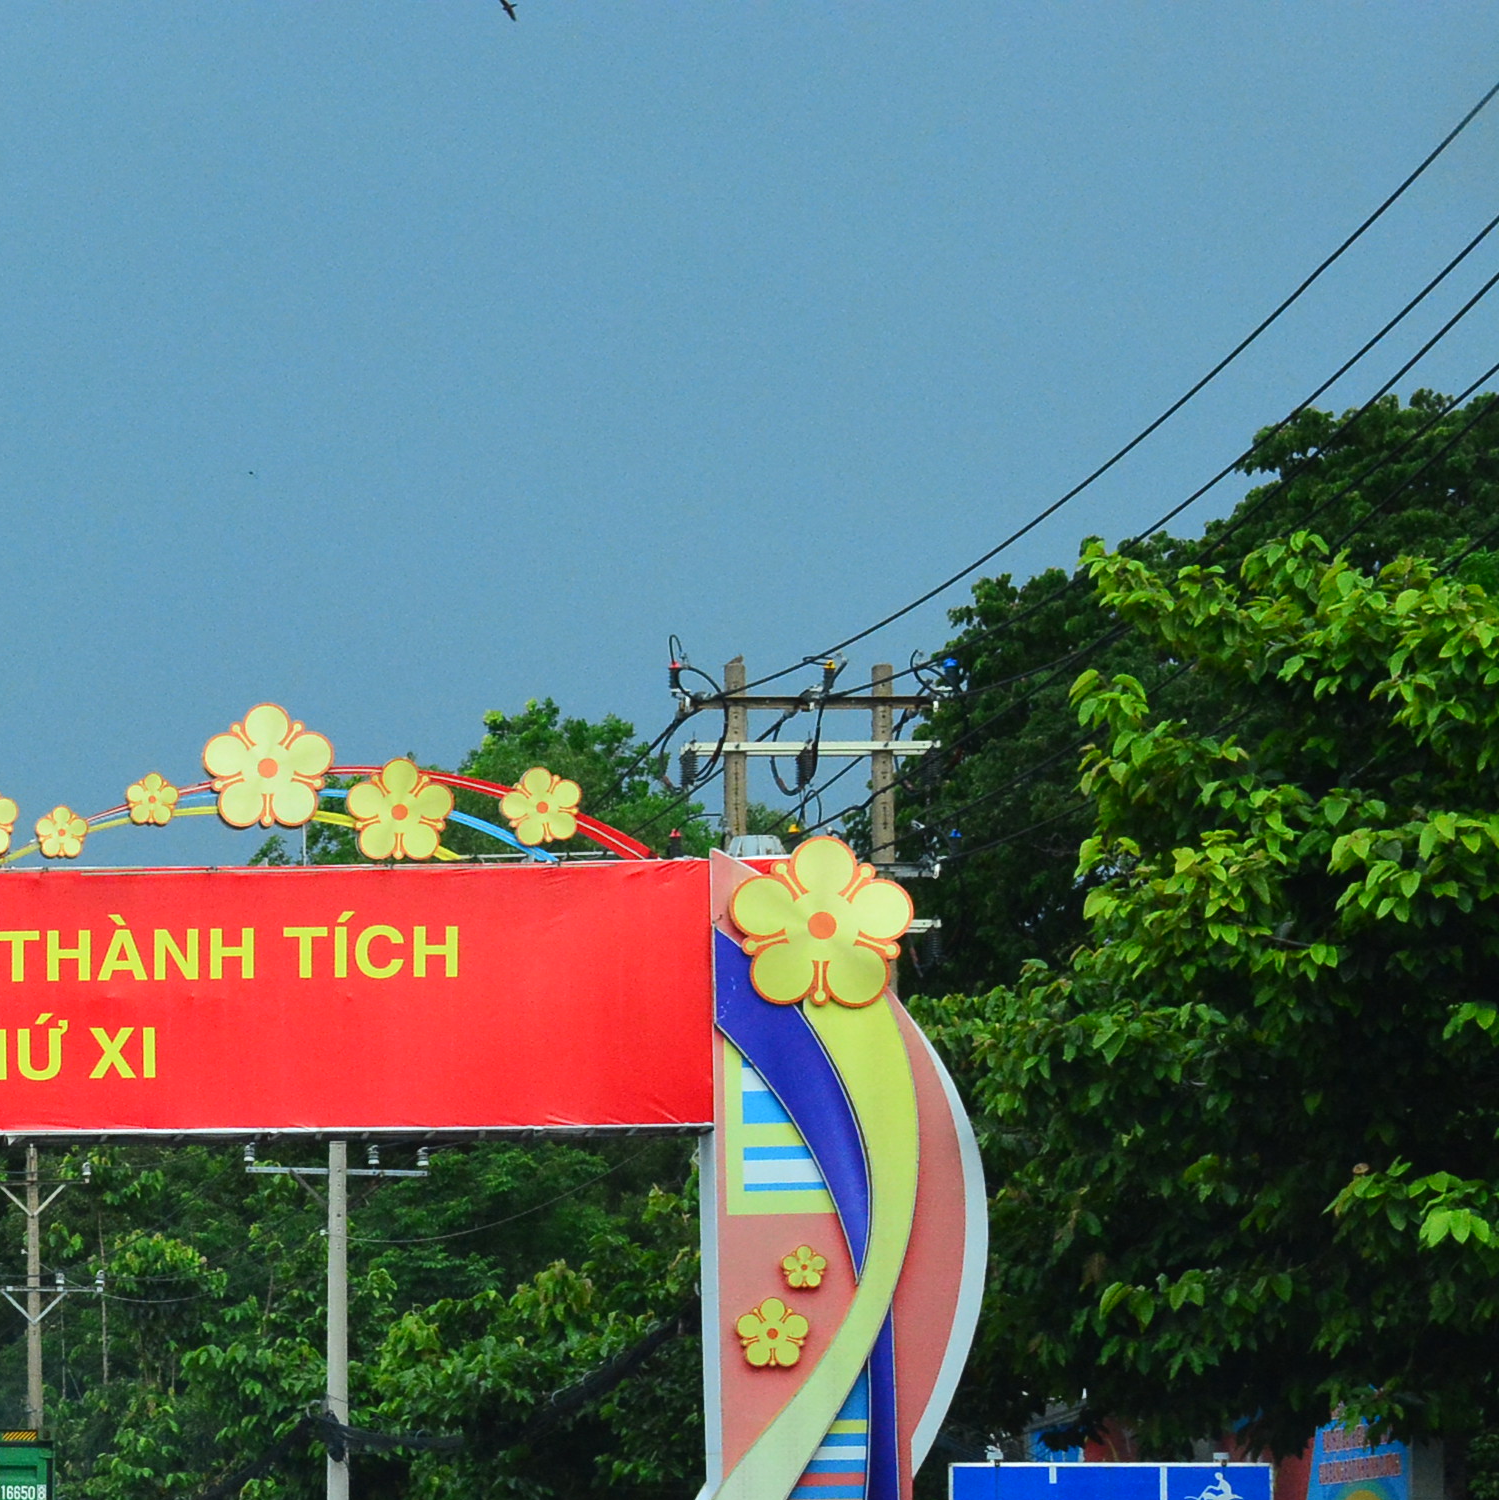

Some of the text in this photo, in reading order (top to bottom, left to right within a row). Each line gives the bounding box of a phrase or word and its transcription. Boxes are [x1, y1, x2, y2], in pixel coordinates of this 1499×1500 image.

[283, 911, 458, 978] TÍCH
[90, 1027, 156, 1079] XI
[38, 1485, 46, 1500] 8
